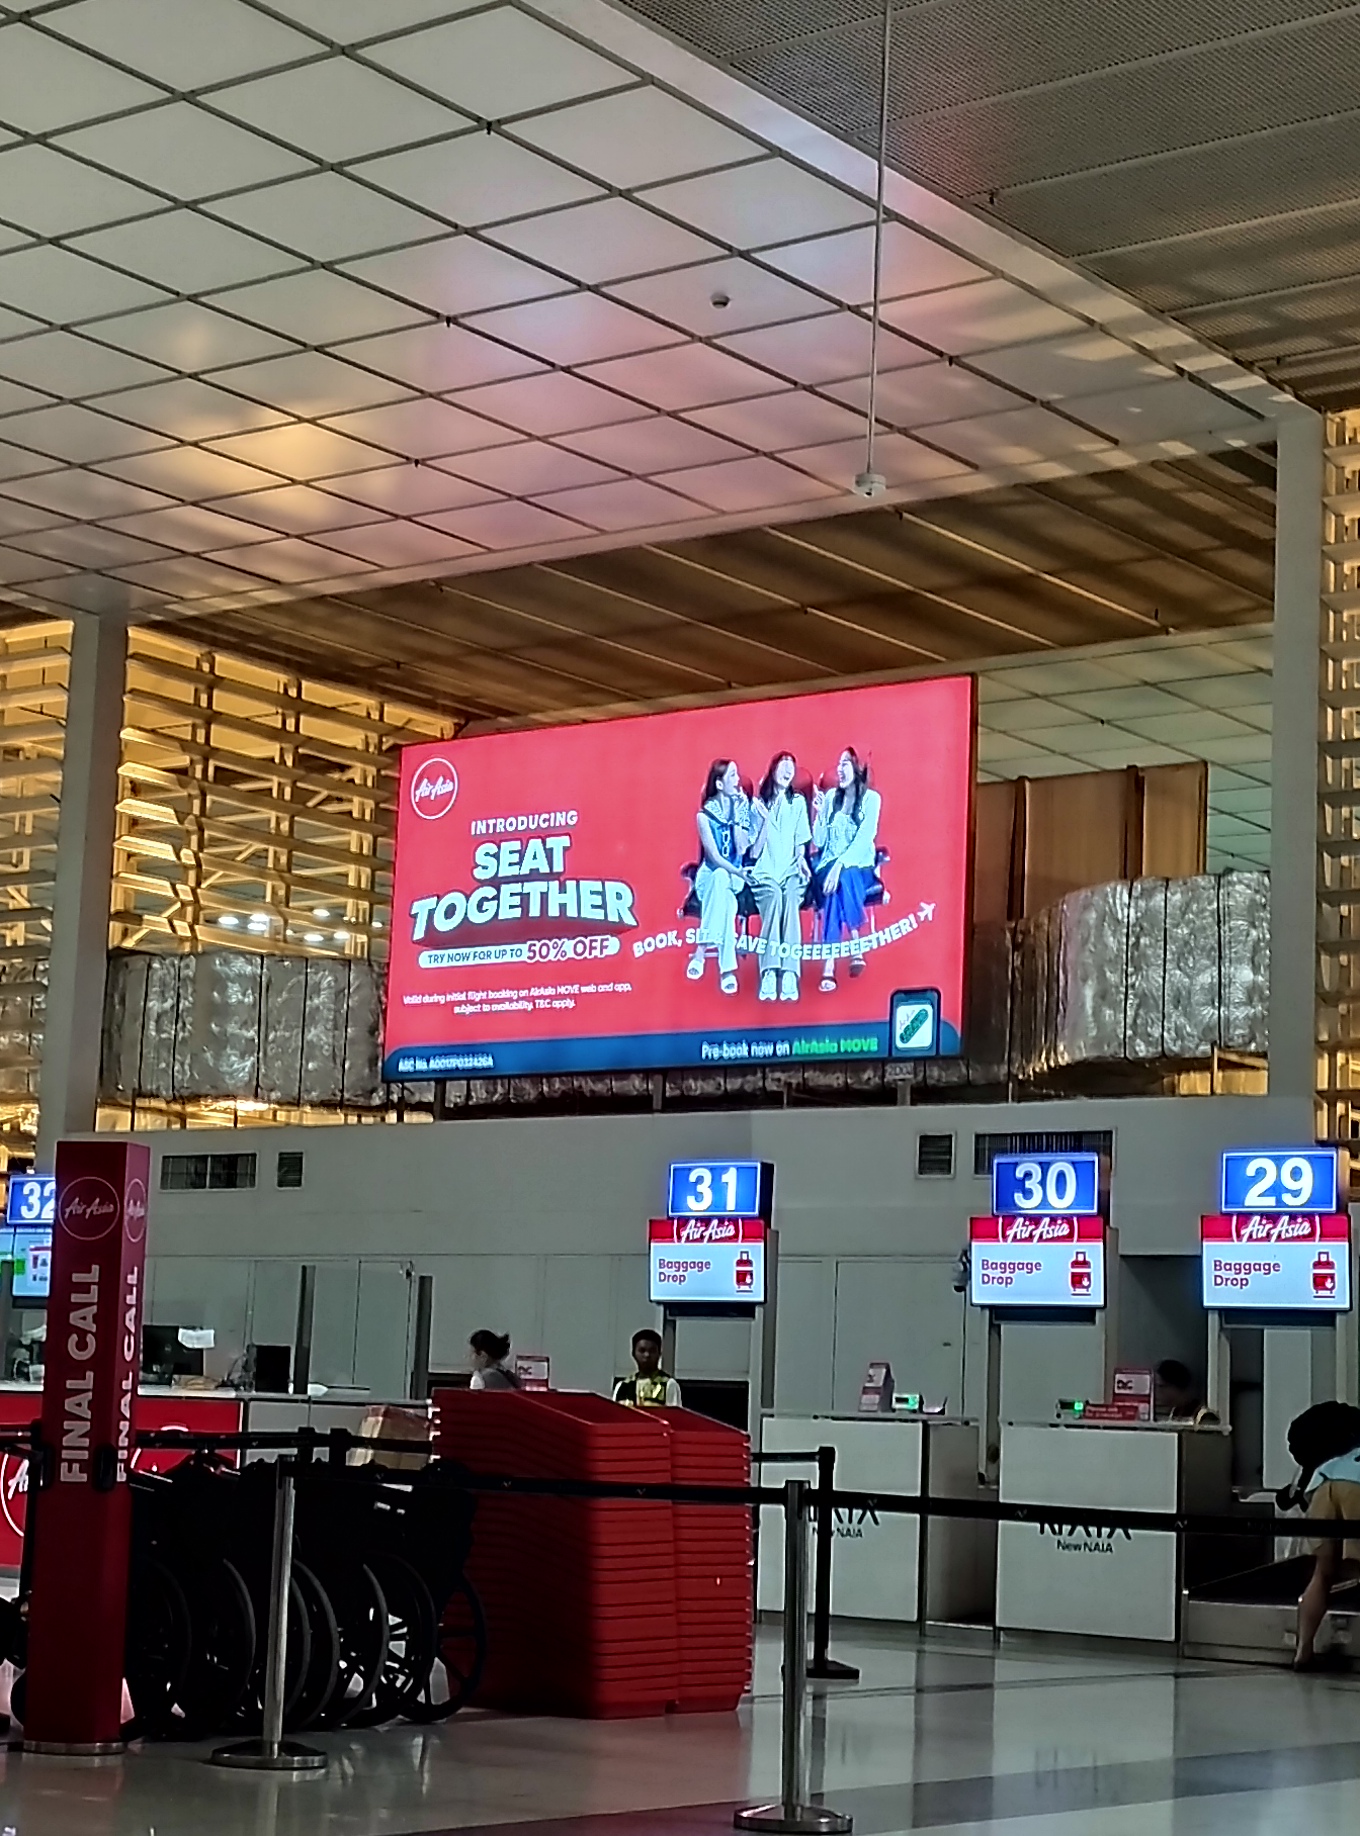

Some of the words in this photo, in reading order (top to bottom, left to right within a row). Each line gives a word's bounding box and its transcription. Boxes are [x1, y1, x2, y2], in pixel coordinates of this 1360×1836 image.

[471, 810, 578, 835] INTRODUCING
[472, 835, 571, 880] SEAT
[410, 879, 638, 941] TOGETHER
[428, 953, 445, 964] TRY
[447, 952, 471, 963] NOW
[472, 950, 492, 961] FOR
[494, 949, 507, 960] UP
[510, 948, 523, 958] TO
[526, 940, 568, 961] 50%
[573, 937, 610, 957] OFF
[632, 930, 682, 958] BOOK,
[519, 989, 529, 998] on
[557, 984, 580, 995] MOVE
[598, 982, 614, 992] and
[482, 1003, 491, 1012] to
[702, 1040, 749, 1059] Pre-book
[750, 1040, 774, 1058] now
[776, 1040, 790, 1056] on
[792, 1037, 839, 1055] AirAsia
[841, 1037, 878, 1054] MOVE
[686, 1167, 737, 1211] 31
[1014, 1162, 1077, 1209] 30
[1244, 1157, 1314, 1206] 29
[20, 1181, 55, 1219] 32
[64, 1196, 115, 1219] AirAsia
[680, 1219, 735, 1243] AirAsia
[1006, 1217, 1070, 1243] AirAsia
[1241, 1215, 1312, 1243] AirAsia
[658, 1259, 711, 1272] Baggage
[658, 1272, 686, 1285] Drop
[981, 1259, 1042, 1274] Baggage
[1213, 1260, 1281, 1275] Baggage
[981, 1274, 1014, 1288] Drop
[1213, 1275, 1249, 1289] Drop
[67, 1264, 100, 1361] CALL
[123, 1265, 138, 1362] CALL
[60, 1370, 95, 1483] FINAL
[116, 1370, 133, 1483] FINAL
[1057, 1540, 1082, 1551] New
[1083, 1541, 1114, 1554] NAIA
